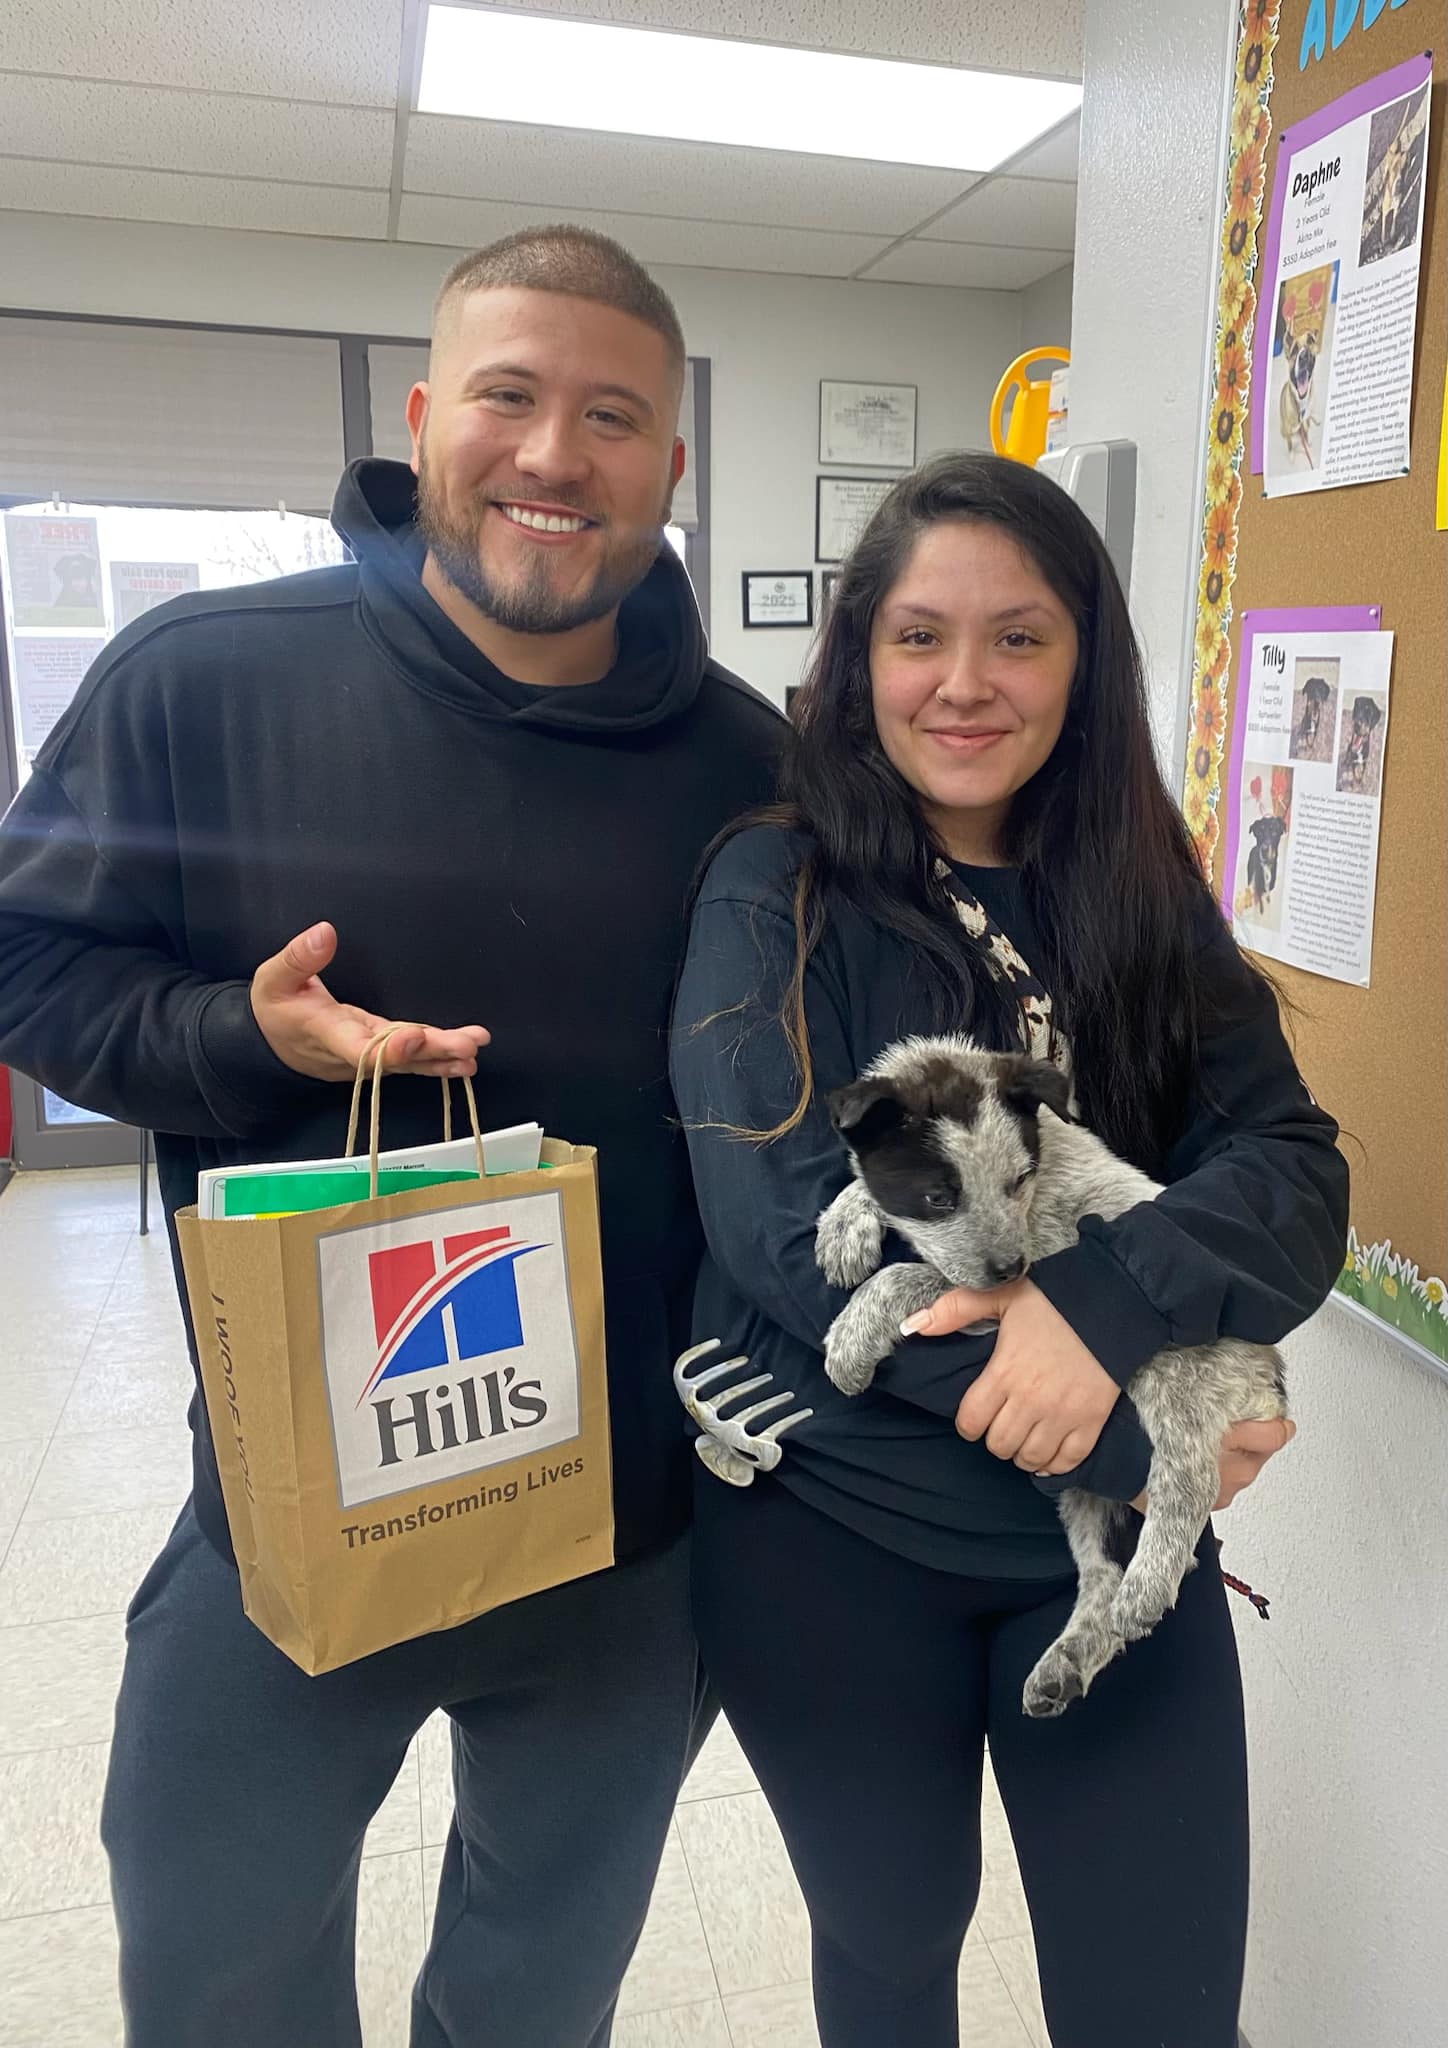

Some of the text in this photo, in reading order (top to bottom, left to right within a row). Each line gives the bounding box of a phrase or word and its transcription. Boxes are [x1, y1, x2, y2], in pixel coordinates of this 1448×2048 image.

[1292, 156, 1341, 199] Daphne
[1262, 644, 1286, 674] Tilly
[211, 1291, 225, 1306] I
[215, 1316, 242, 1427] WOOF
[370, 1366, 548, 1468] Hill's
[341, 1457, 585, 1549] Transforming Lives
